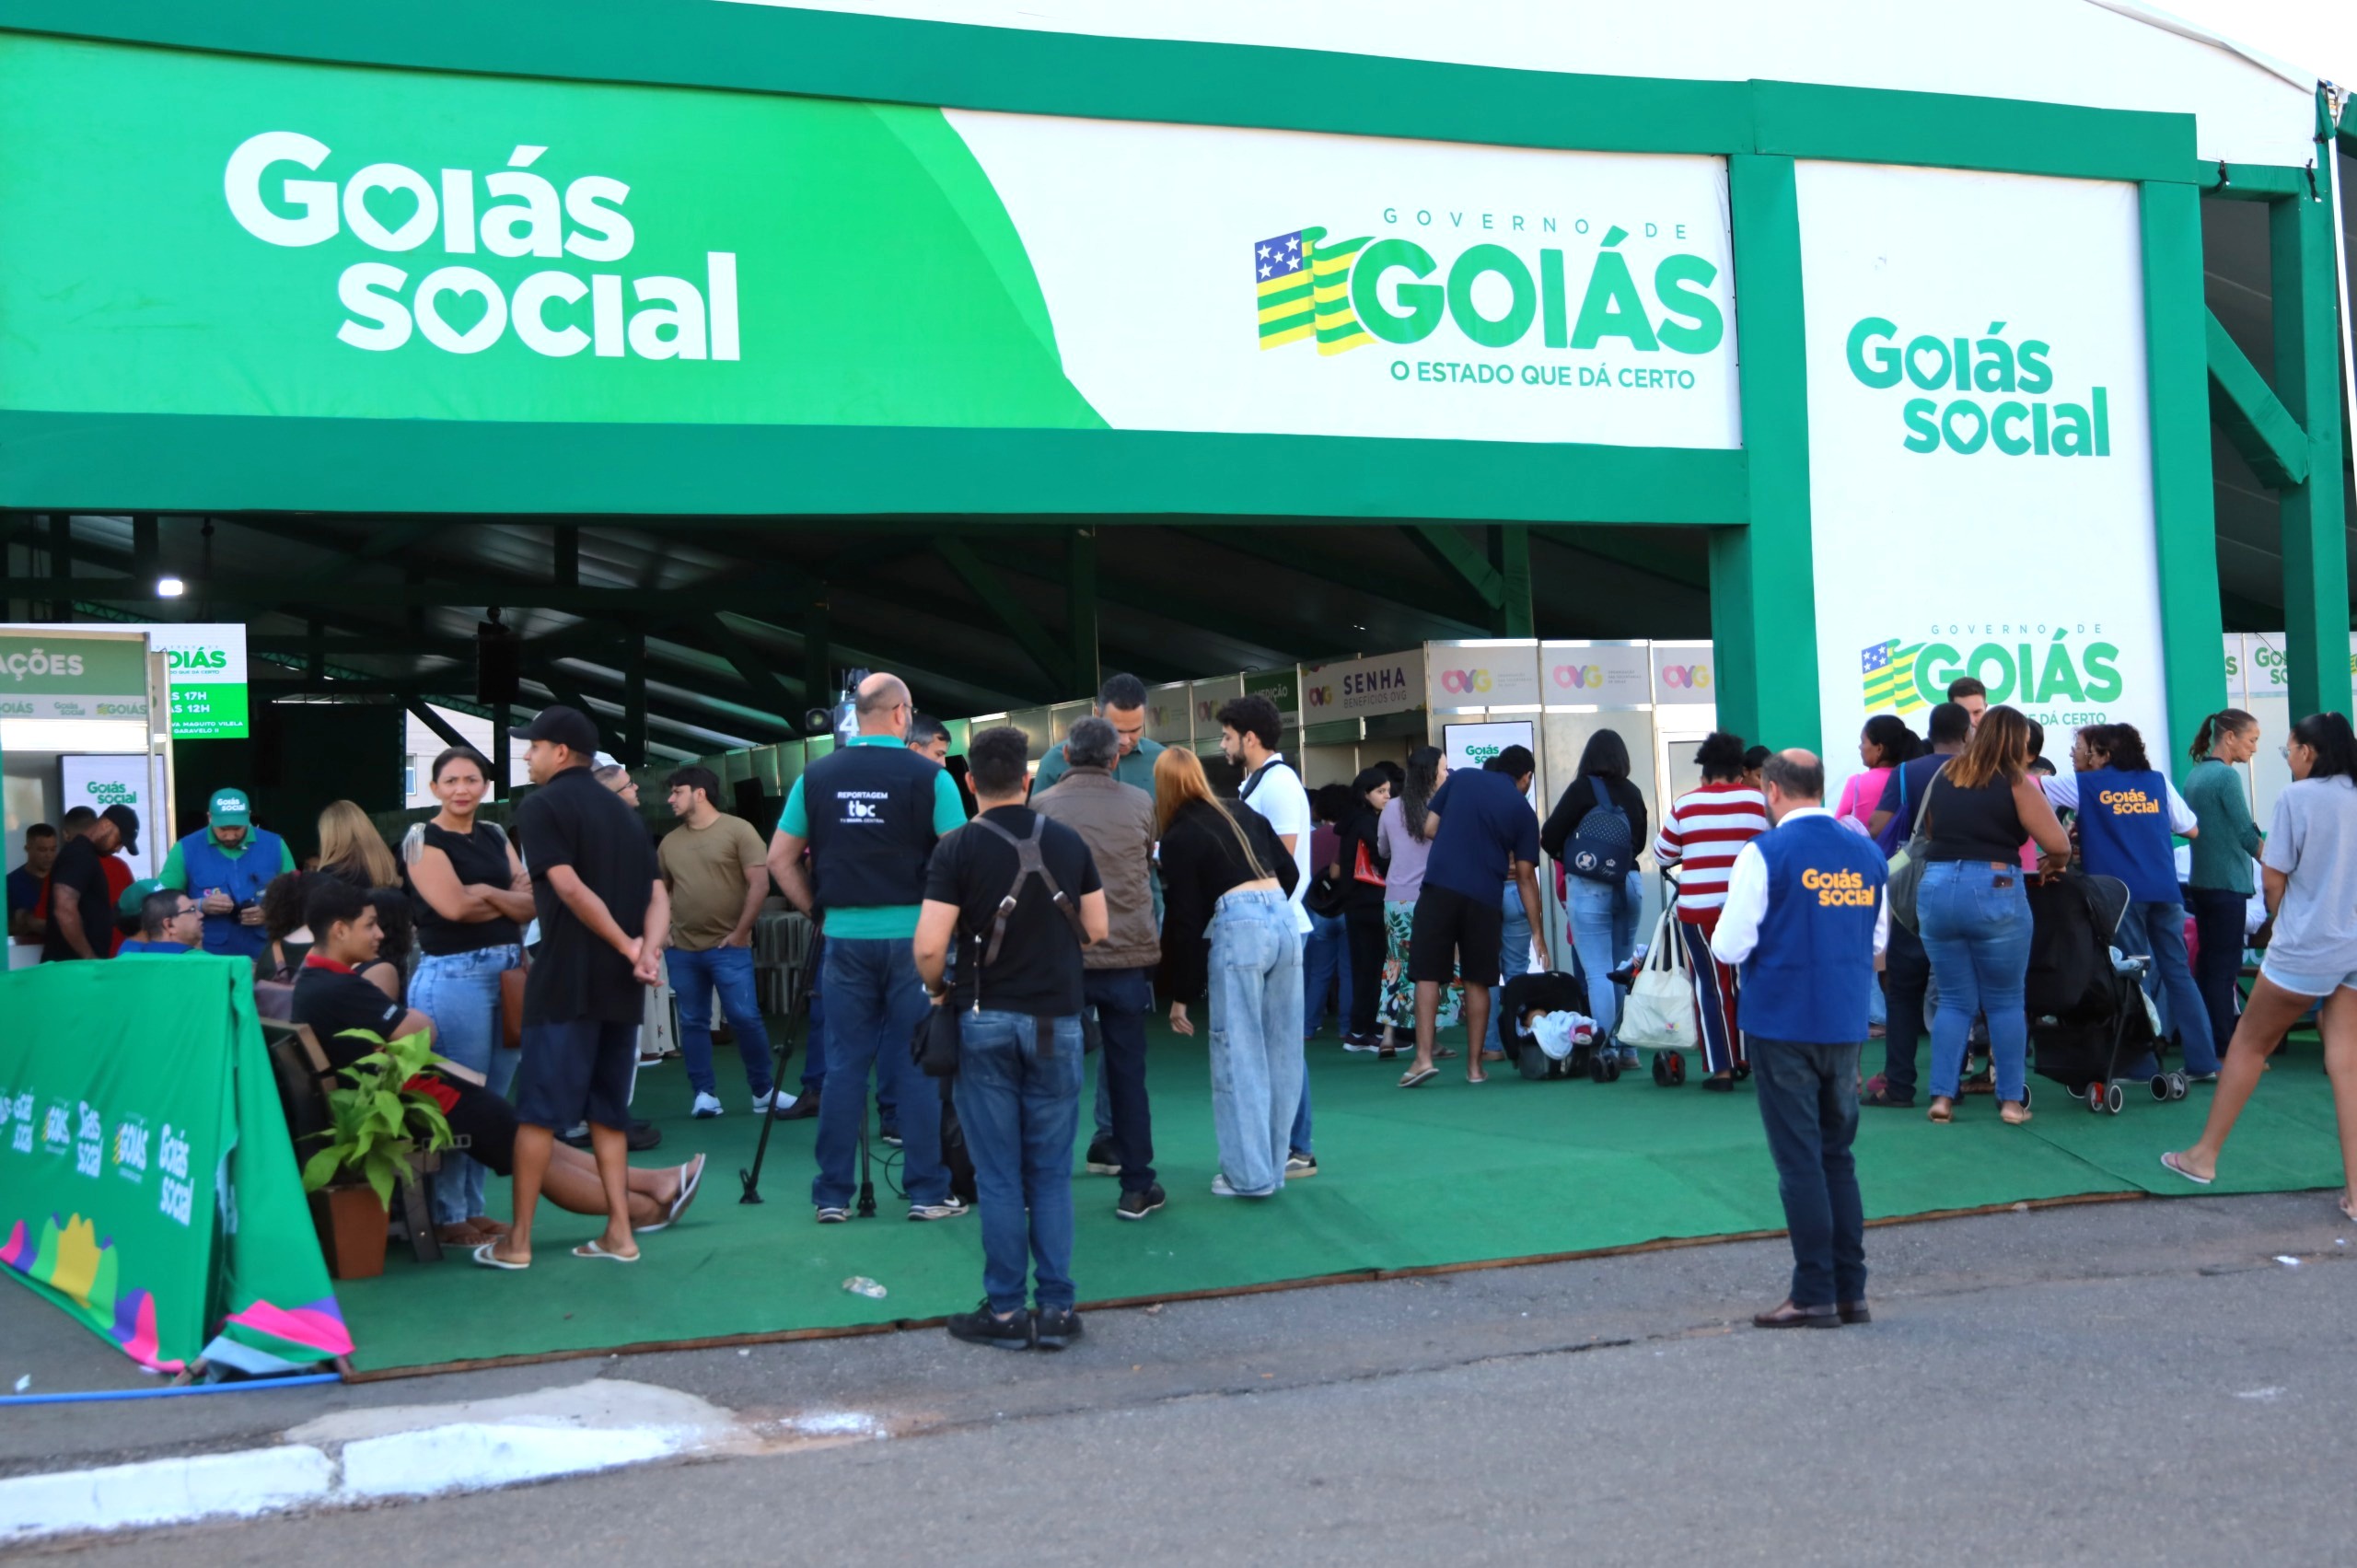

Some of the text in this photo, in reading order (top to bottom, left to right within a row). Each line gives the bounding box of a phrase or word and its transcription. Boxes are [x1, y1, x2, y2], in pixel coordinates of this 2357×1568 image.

[224, 131, 635, 261] Goiás
[1383, 207, 1687, 240] GOVERNO DE
[1351, 225, 1724, 354] GOIÁS
[336, 250, 741, 362] social
[1846, 316, 2053, 395] Goiás
[1390, 359, 1696, 389] O ESTADO QUE DÁ CERTO
[1902, 386, 2111, 458] social
[1931, 623, 2101, 634] GOVERNO DE
[1914, 627, 2123, 705] GOIÁS
[2254, 646, 2288, 668] Goi
[1343, 667, 1407, 695] SENHA
[1441, 668, 1492, 694] OVG
[1552, 664, 1604, 689] OVG
[1662, 665, 1711, 689] OVG
[184, 691, 207, 701] 17H
[1308, 684, 1333, 707] OVG
[1343, 690, 1407, 709] BENEFÍCIOS OVG
[0, 701, 34, 714] OIÁS
[107, 702, 147, 714] GOIÁS
[187, 704, 210, 713] 12H
[2039, 710, 2059, 726] DÁ
[2062, 712, 2107, 726] CERTO
[839, 709, 860, 738] 4
[1465, 744, 1500, 756] Goiás
[87, 781, 126, 795] Goiás
[97, 791, 137, 805] social
[837, 791, 888, 799] REPORTAGEM
[2099, 788, 2147, 805] Goiás
[216, 796, 240, 807] Goiás
[221, 802, 246, 811] social
[848, 799, 876, 818] tbc
[2112, 798, 2160, 816] social
[1801, 868, 1864, 890] Goiás
[1818, 885, 1875, 907] social
[158, 1122, 191, 1180] Goiás
[159, 1175, 195, 1227] social
